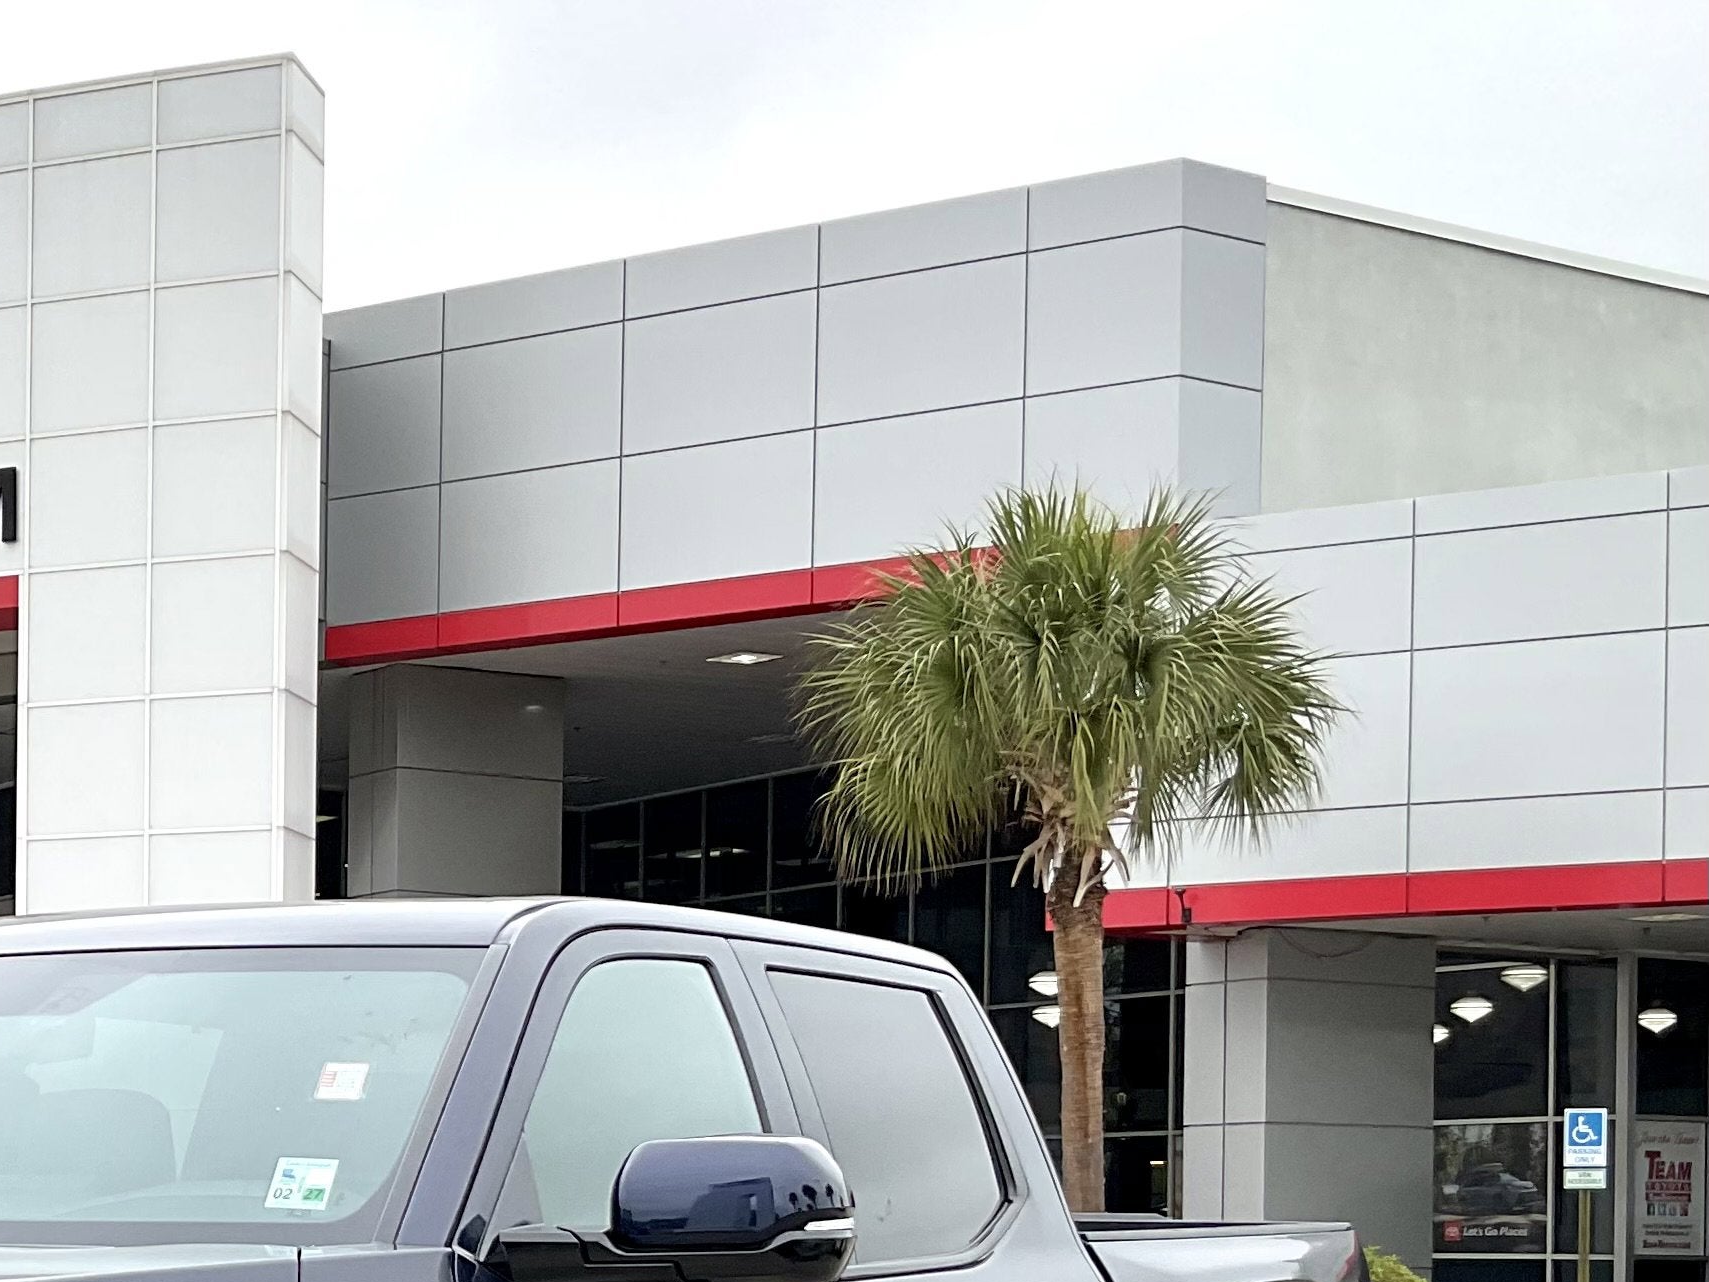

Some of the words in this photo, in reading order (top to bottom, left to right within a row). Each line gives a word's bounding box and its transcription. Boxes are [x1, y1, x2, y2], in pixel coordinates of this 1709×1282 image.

[273, 1187, 293, 1200] 02
[303, 1187, 323, 1201] 27
[1484, 1226, 1498, 1236] Go
